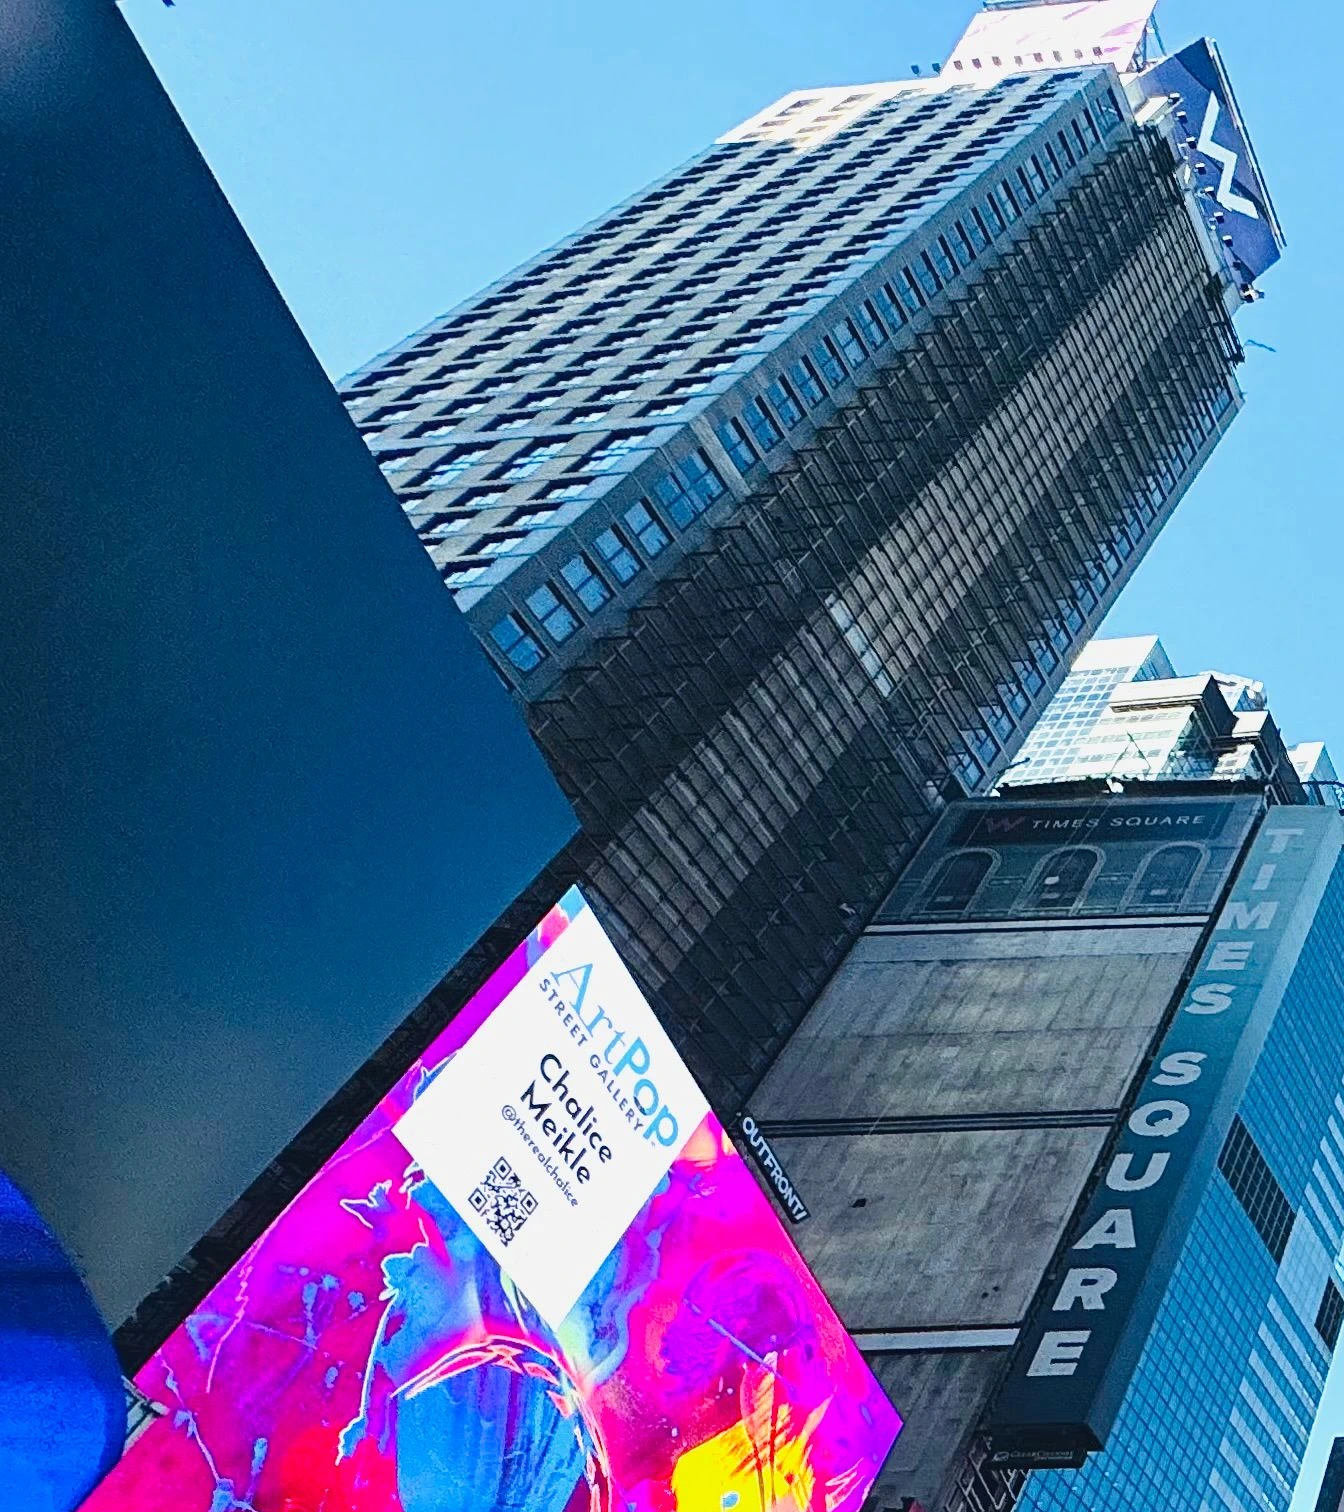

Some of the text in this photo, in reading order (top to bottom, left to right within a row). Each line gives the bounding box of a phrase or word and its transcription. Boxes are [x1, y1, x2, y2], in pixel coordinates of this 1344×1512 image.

[1032, 818, 1100, 829] TIMES
[1109, 815, 1206, 828] SQUARE
[1184, 828, 1305, 1015] TIMES
[539, 978, 644, 1132] STREET GALLERY
[539, 1053, 614, 1164] Chalice
[551, 963, 679, 1148] ArtPop
[501, 1104, 579, 1208] @therealchalice
[519, 1079, 591, 1185] Meikle
[1025, 1051, 1209, 1378] SQUARE
